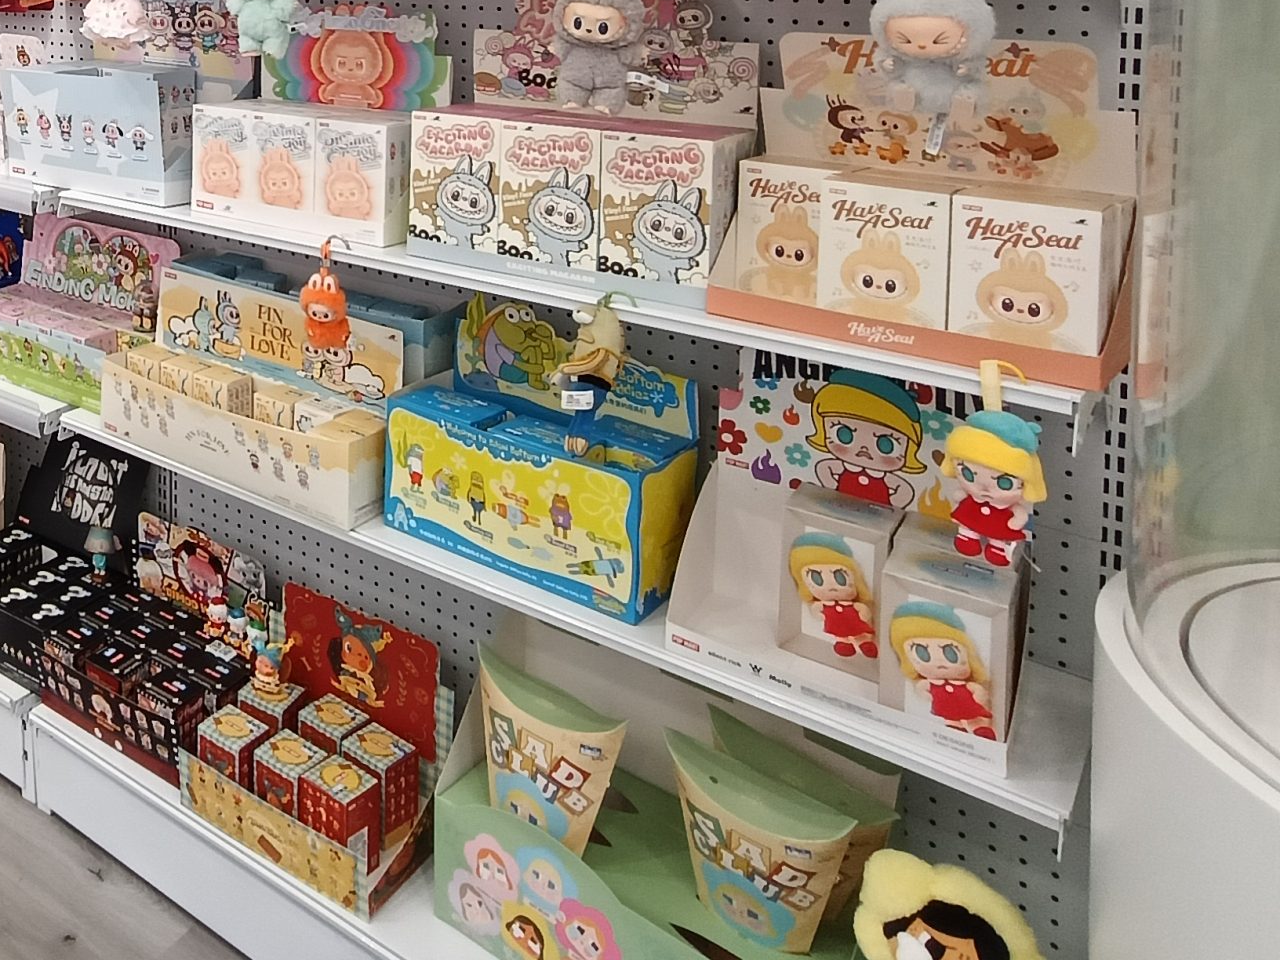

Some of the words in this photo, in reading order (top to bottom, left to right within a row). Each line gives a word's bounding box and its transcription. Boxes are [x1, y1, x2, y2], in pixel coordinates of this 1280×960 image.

[986, 53, 1037, 77] eat
[426, 125, 491, 144] EXCITING
[519, 136, 589, 156] EXCITING
[418, 141, 483, 158] MACARON
[508, 151, 580, 171] MACARON
[620, 147, 700, 169] EXCITING
[610, 161, 690, 184] MACARON
[749, 178, 797, 199] Have
[791, 184, 821, 204] Sea
[832, 200, 887, 221] Have
[881, 207, 934, 230] Seat
[966, 216, 1029, 240] Have
[1022, 225, 1083, 250] Seat
[98, 283, 135, 311] MOK
[257, 303, 284, 324] PIN
[261, 322, 298, 349] FOR
[848, 322, 884, 338] Have
[882, 329, 915, 346] Seat
[250, 338, 291, 361] LOVE
[494, 717, 584, 788] SAD
[491, 741, 588, 812] CLUB
[694, 811, 808, 887] SAD
[693, 828, 816, 908] CLUB
